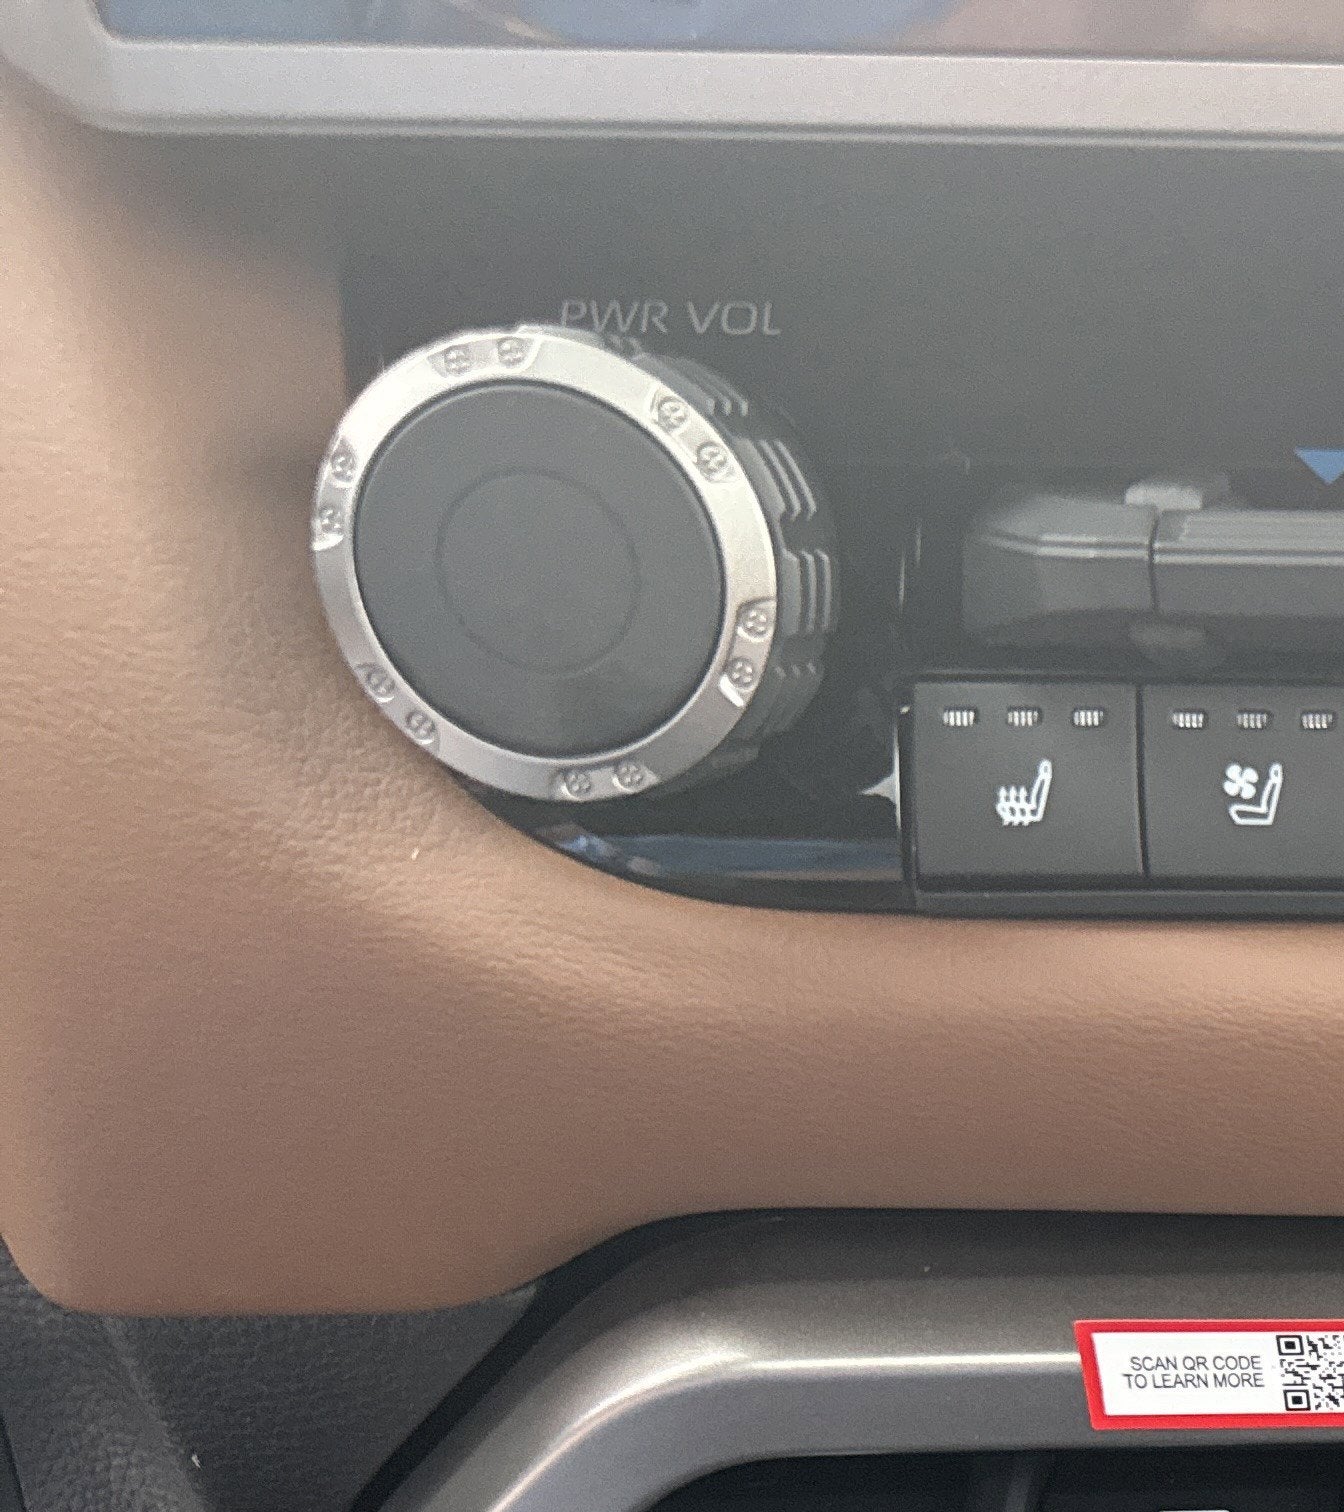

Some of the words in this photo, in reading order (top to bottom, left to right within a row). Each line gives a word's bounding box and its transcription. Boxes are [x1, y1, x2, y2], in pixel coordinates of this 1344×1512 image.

[560, 299, 669, 334] PWR
[686, 300, 781, 336] VOL
[1130, 1356, 1178, 1371] SCAN
[1183, 1356, 1209, 1370] QR
[1213, 1356, 1262, 1370] CODE
[1122, 1374, 1147, 1388] TO
[1152, 1374, 1209, 1388] LEARN
[1214, 1373, 1265, 1388] MORE
